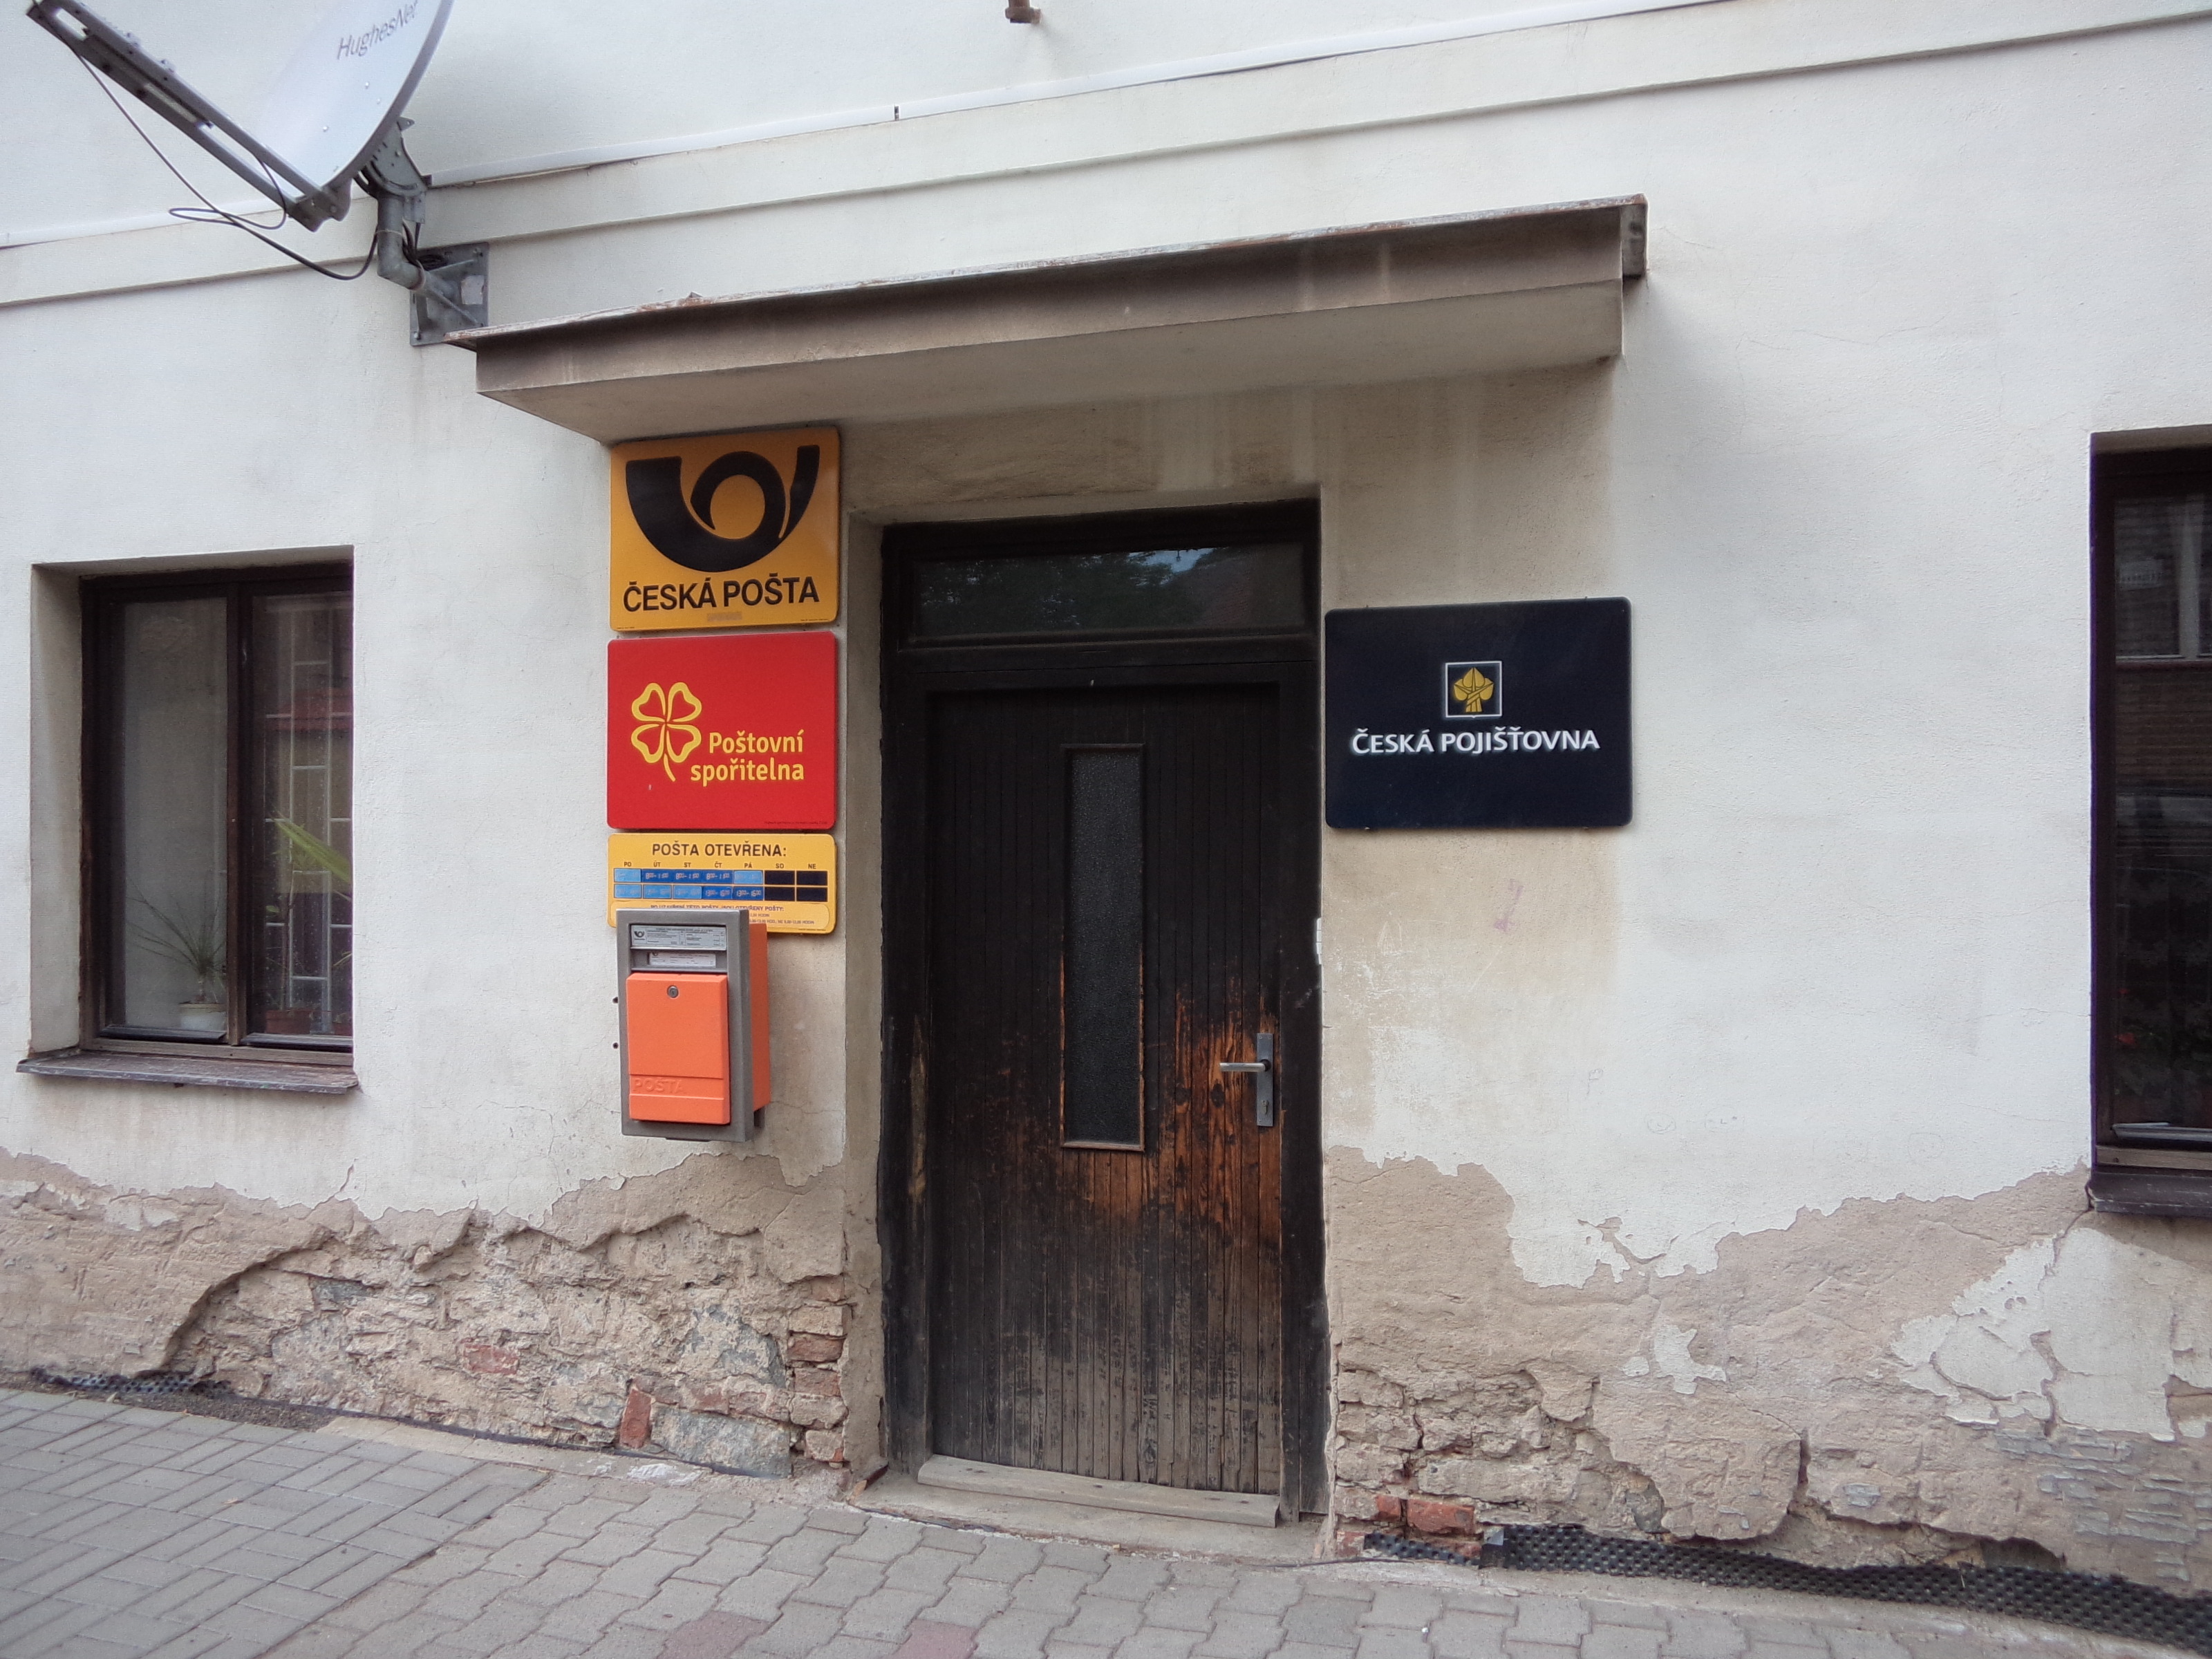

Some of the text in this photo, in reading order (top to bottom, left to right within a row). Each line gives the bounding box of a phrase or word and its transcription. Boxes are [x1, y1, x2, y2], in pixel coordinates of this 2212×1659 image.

[623, 572, 820, 612] ČESKÁ POŠTA
[709, 729, 804, 753] Poštovní
[1352, 726, 1600, 754] ČESKÁ POJIŠŤOVNA
[691, 757, 804, 787] spořitelna
[652, 841, 787, 856] POŠTA OTEVŘENA:
